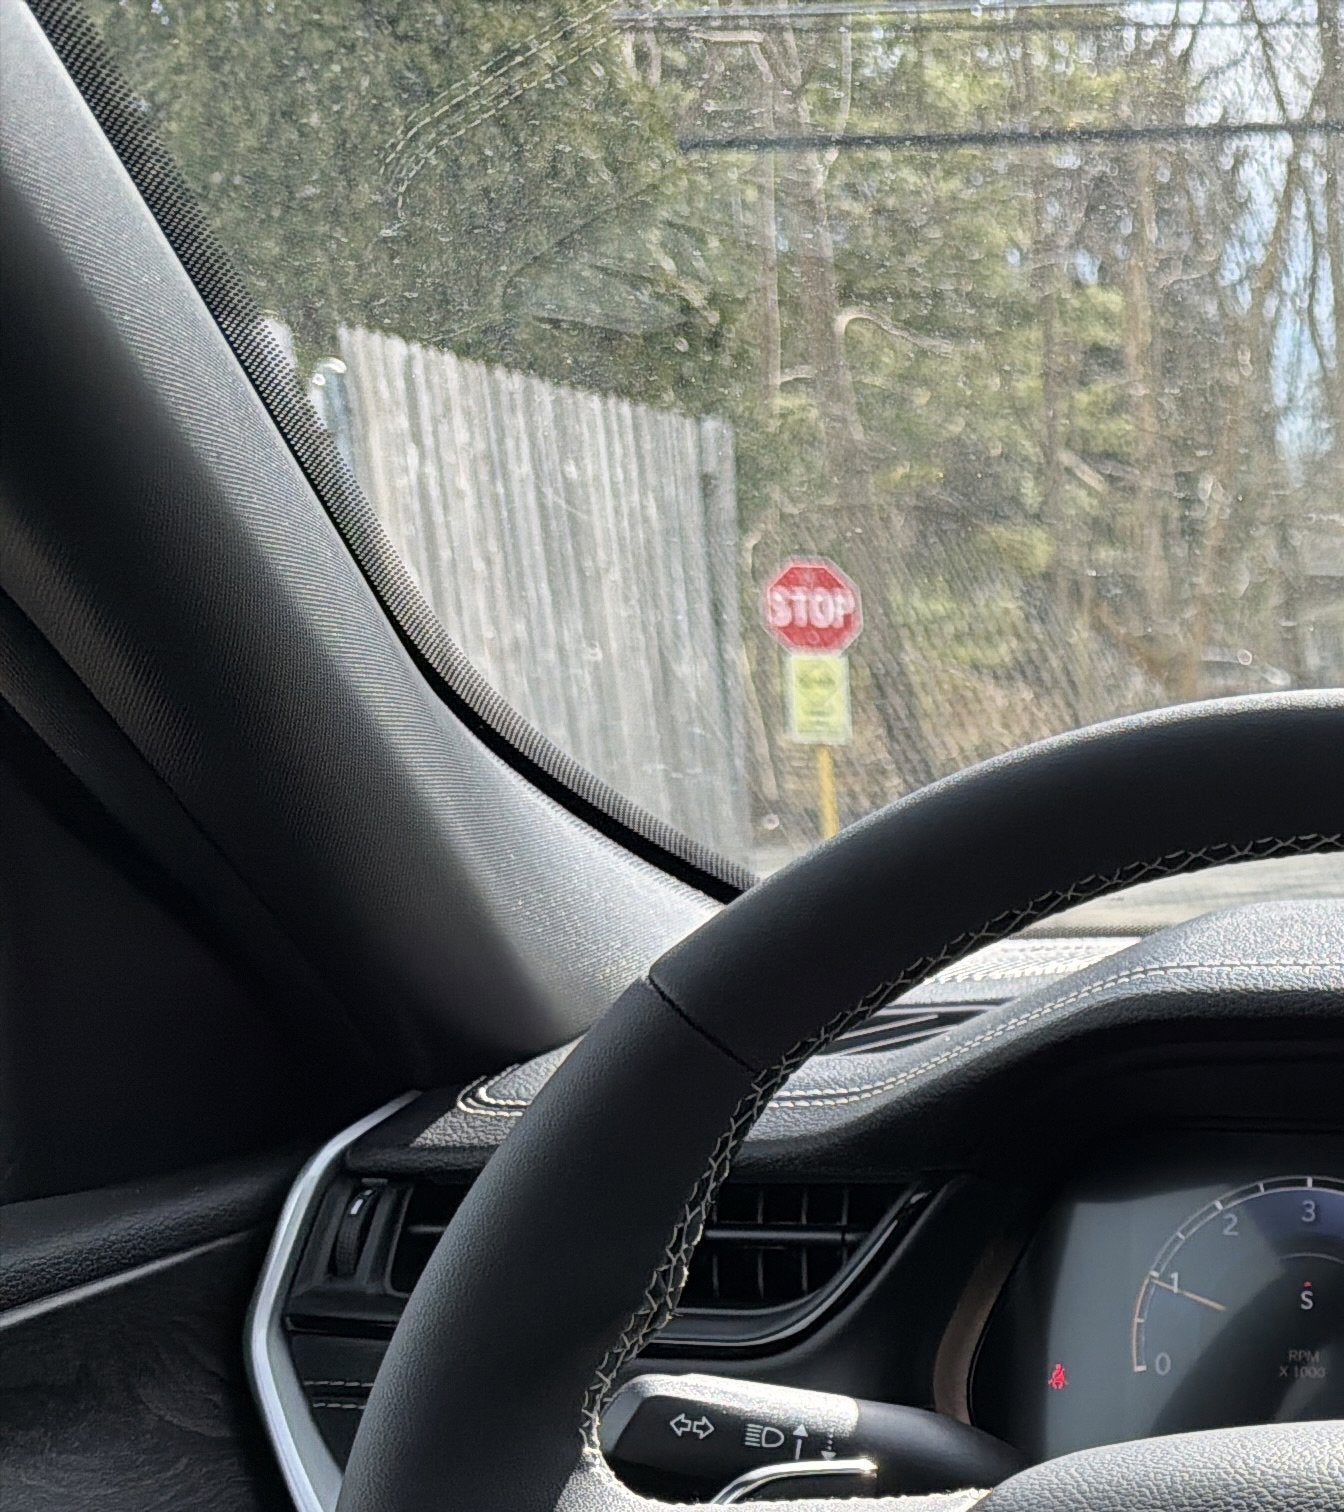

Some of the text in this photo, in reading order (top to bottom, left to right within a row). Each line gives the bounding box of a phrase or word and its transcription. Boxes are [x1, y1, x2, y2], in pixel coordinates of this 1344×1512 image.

[769, 585, 855, 628] STOP
[1302, 1202, 1316, 1223] 3
[1222, 1214, 1239, 1236] 2
[1168, 1272, 1180, 1293] 1
[1300, 1290, 1314, 1310] S
[1154, 1353, 1172, 1376] 0
[1288, 1350, 1320, 1362] RPM
